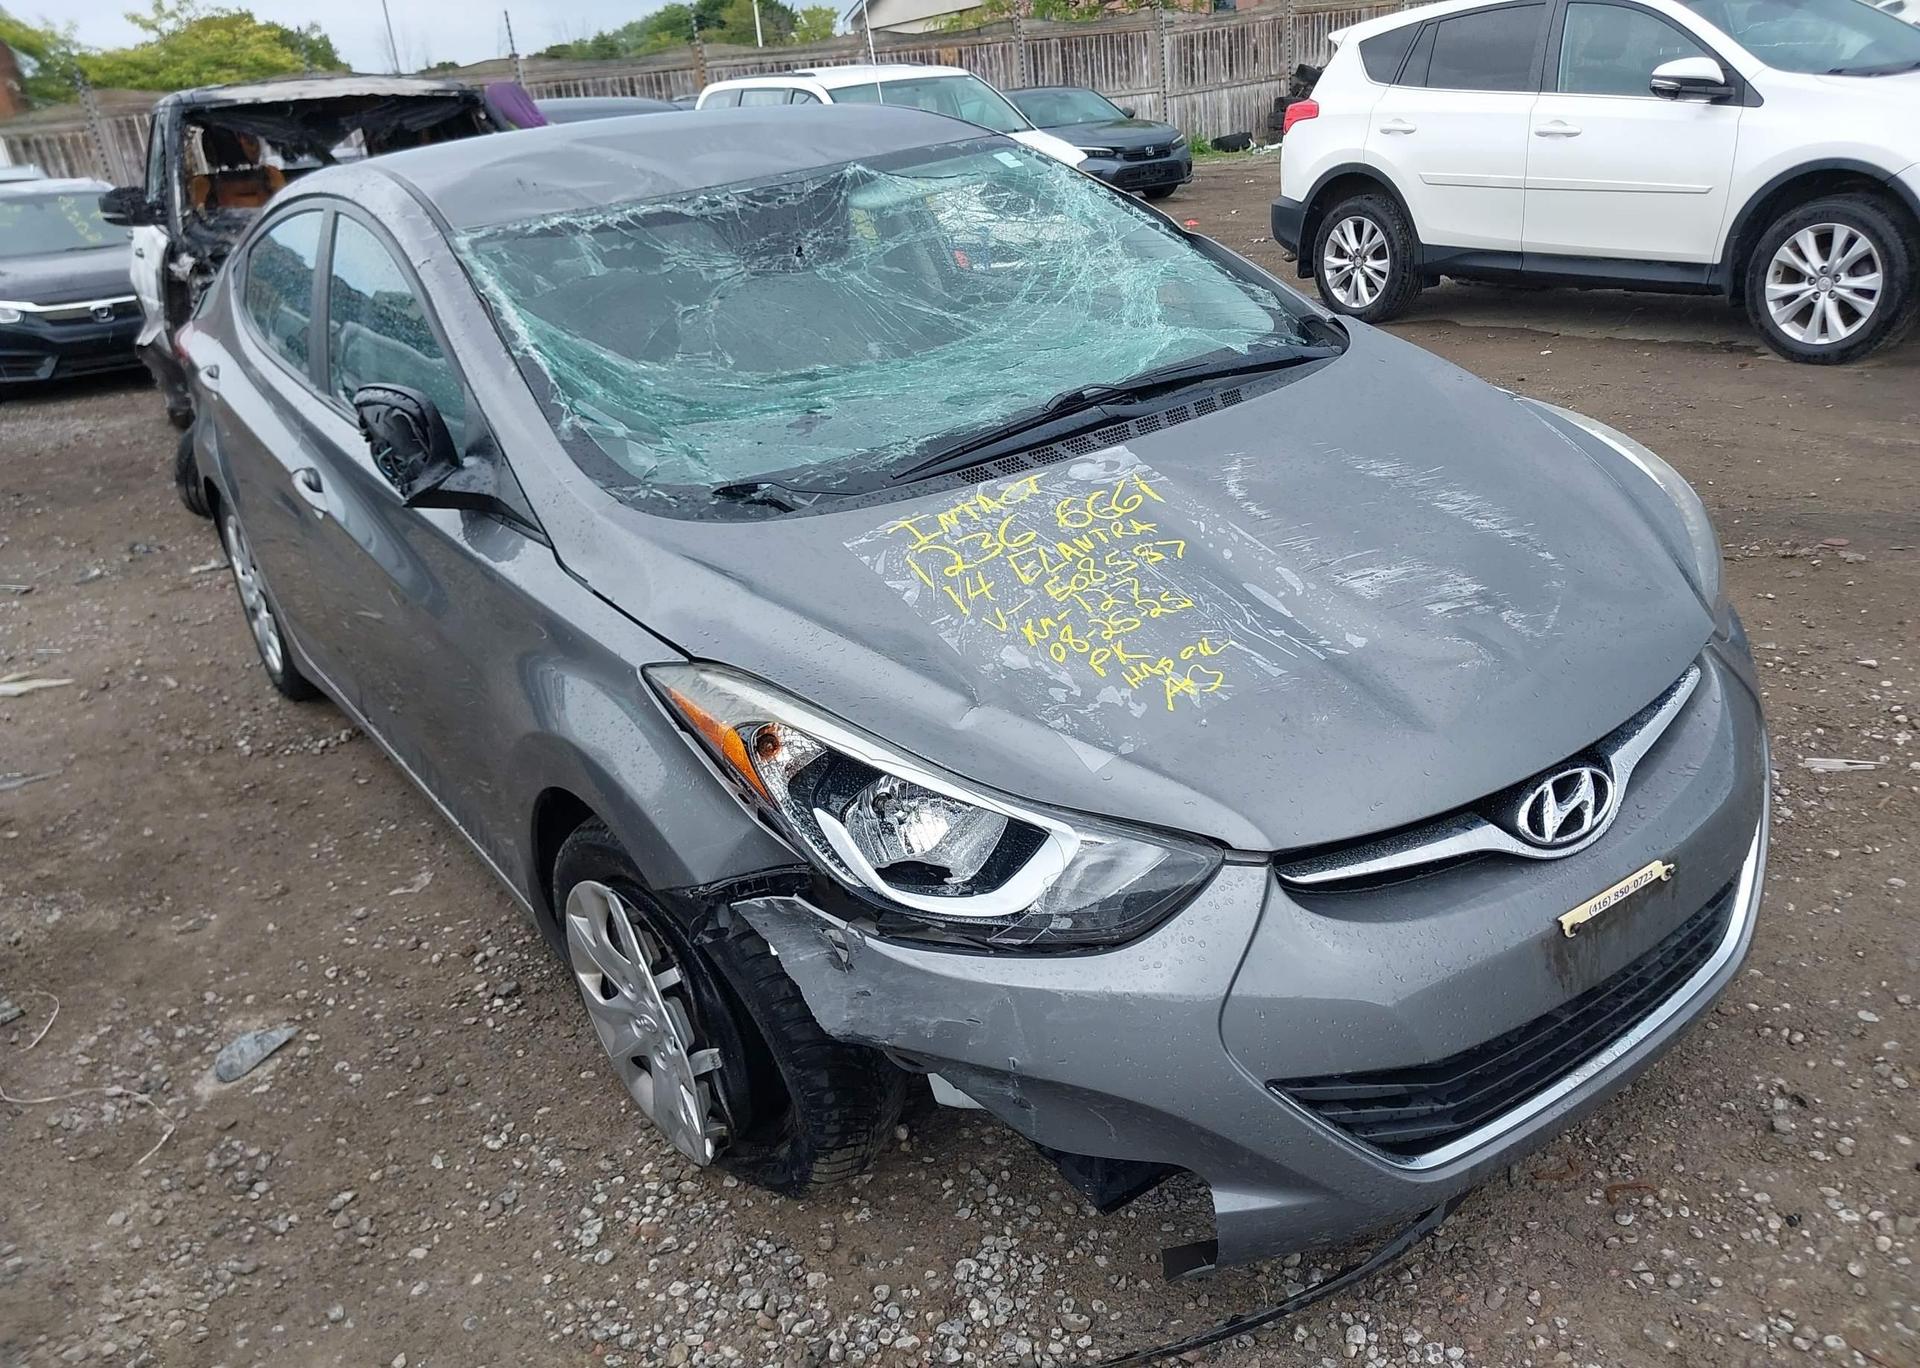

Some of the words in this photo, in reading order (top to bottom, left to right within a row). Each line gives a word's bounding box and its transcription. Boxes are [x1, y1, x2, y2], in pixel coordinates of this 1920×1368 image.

[943, 570, 996, 616] 14
[1007, 519, 1158, 584] ELANTRA
[1588, 895, 1611, 916] (416)
